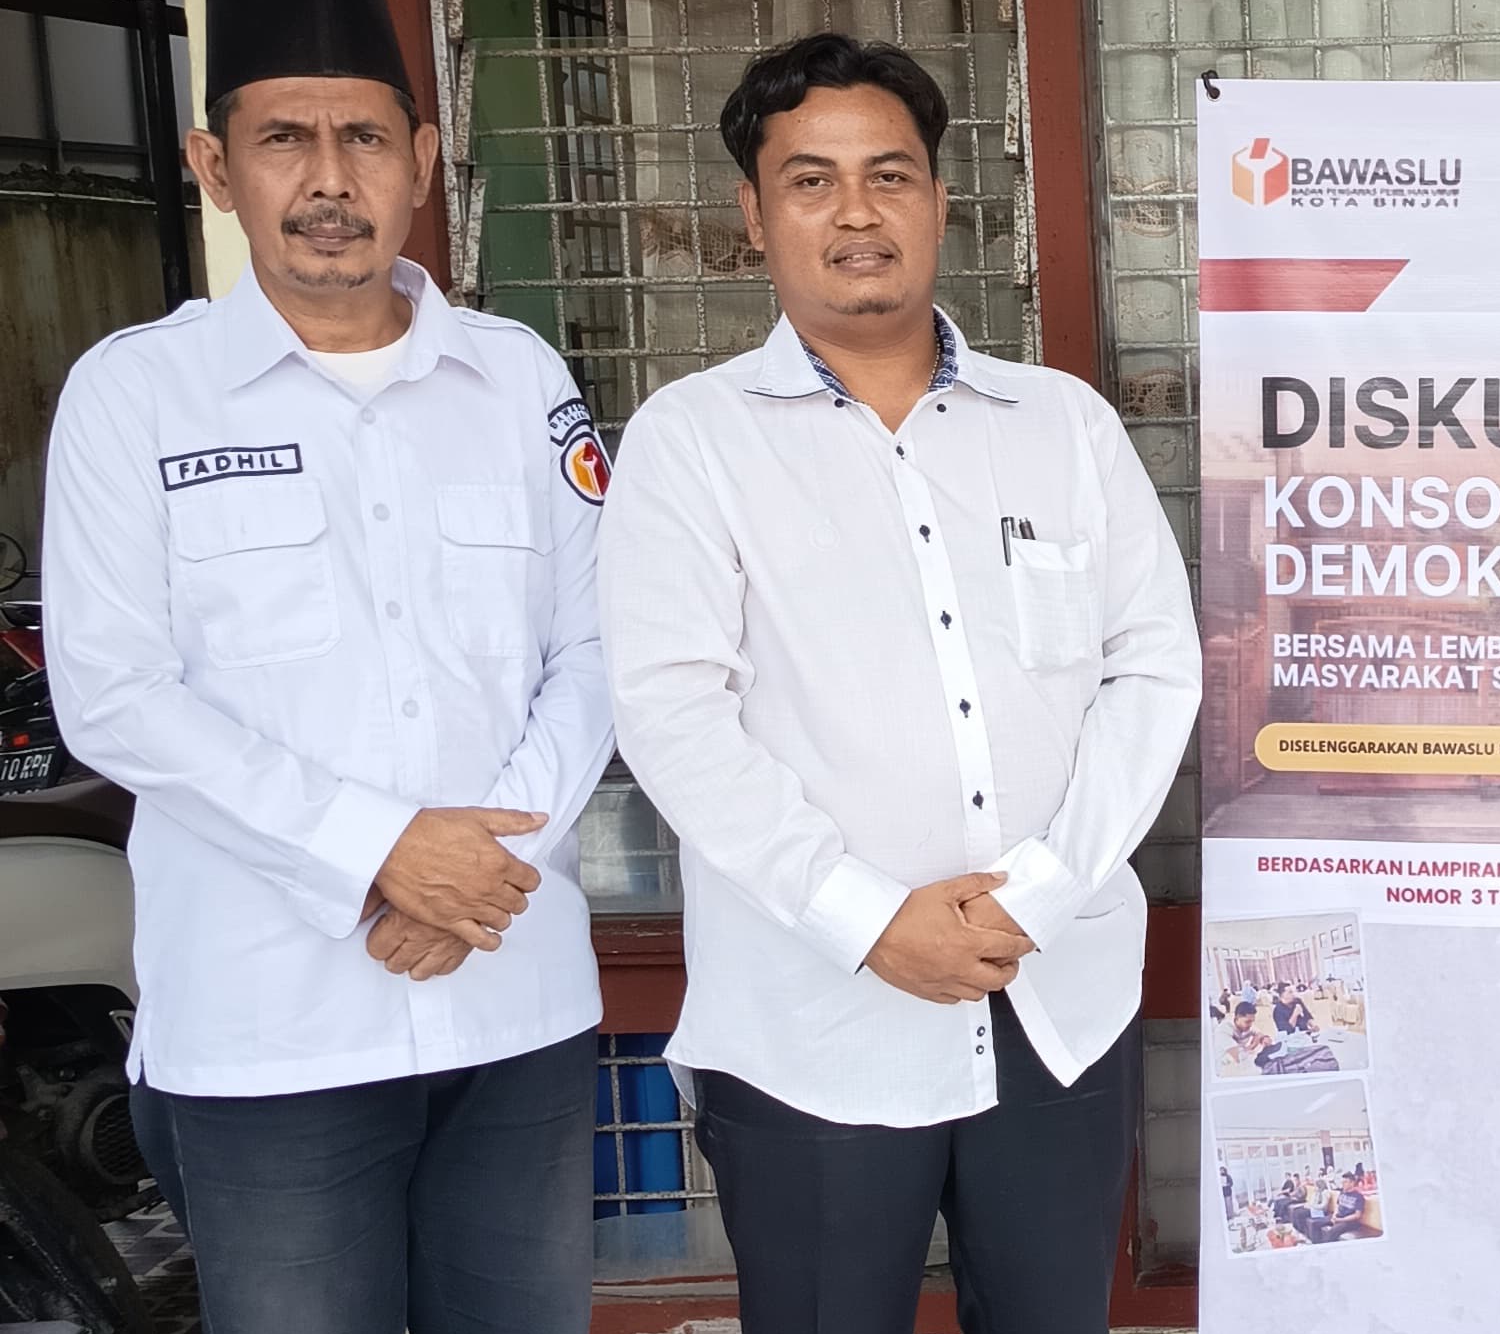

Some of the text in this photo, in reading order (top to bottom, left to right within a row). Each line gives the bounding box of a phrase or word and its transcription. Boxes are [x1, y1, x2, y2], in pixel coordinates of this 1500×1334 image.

[1291, 158, 1462, 186] BAWASLU
[1291, 197, 1459, 208] KOTA BINJAI
[178, 452, 284, 480] FADHIL
[1273, 633, 1417, 659] BERSAMA
[1272, 663, 1482, 690] MASYARAKAT
[1279, 739, 1419, 755] DISELENGGARAKAN
[1423, 742, 1495, 756] BAWASLU
[1257, 855, 1403, 876] BERDASARKAN
[1386, 887, 1461, 905] NOMOR
[1471, 888, 1483, 906] 3
